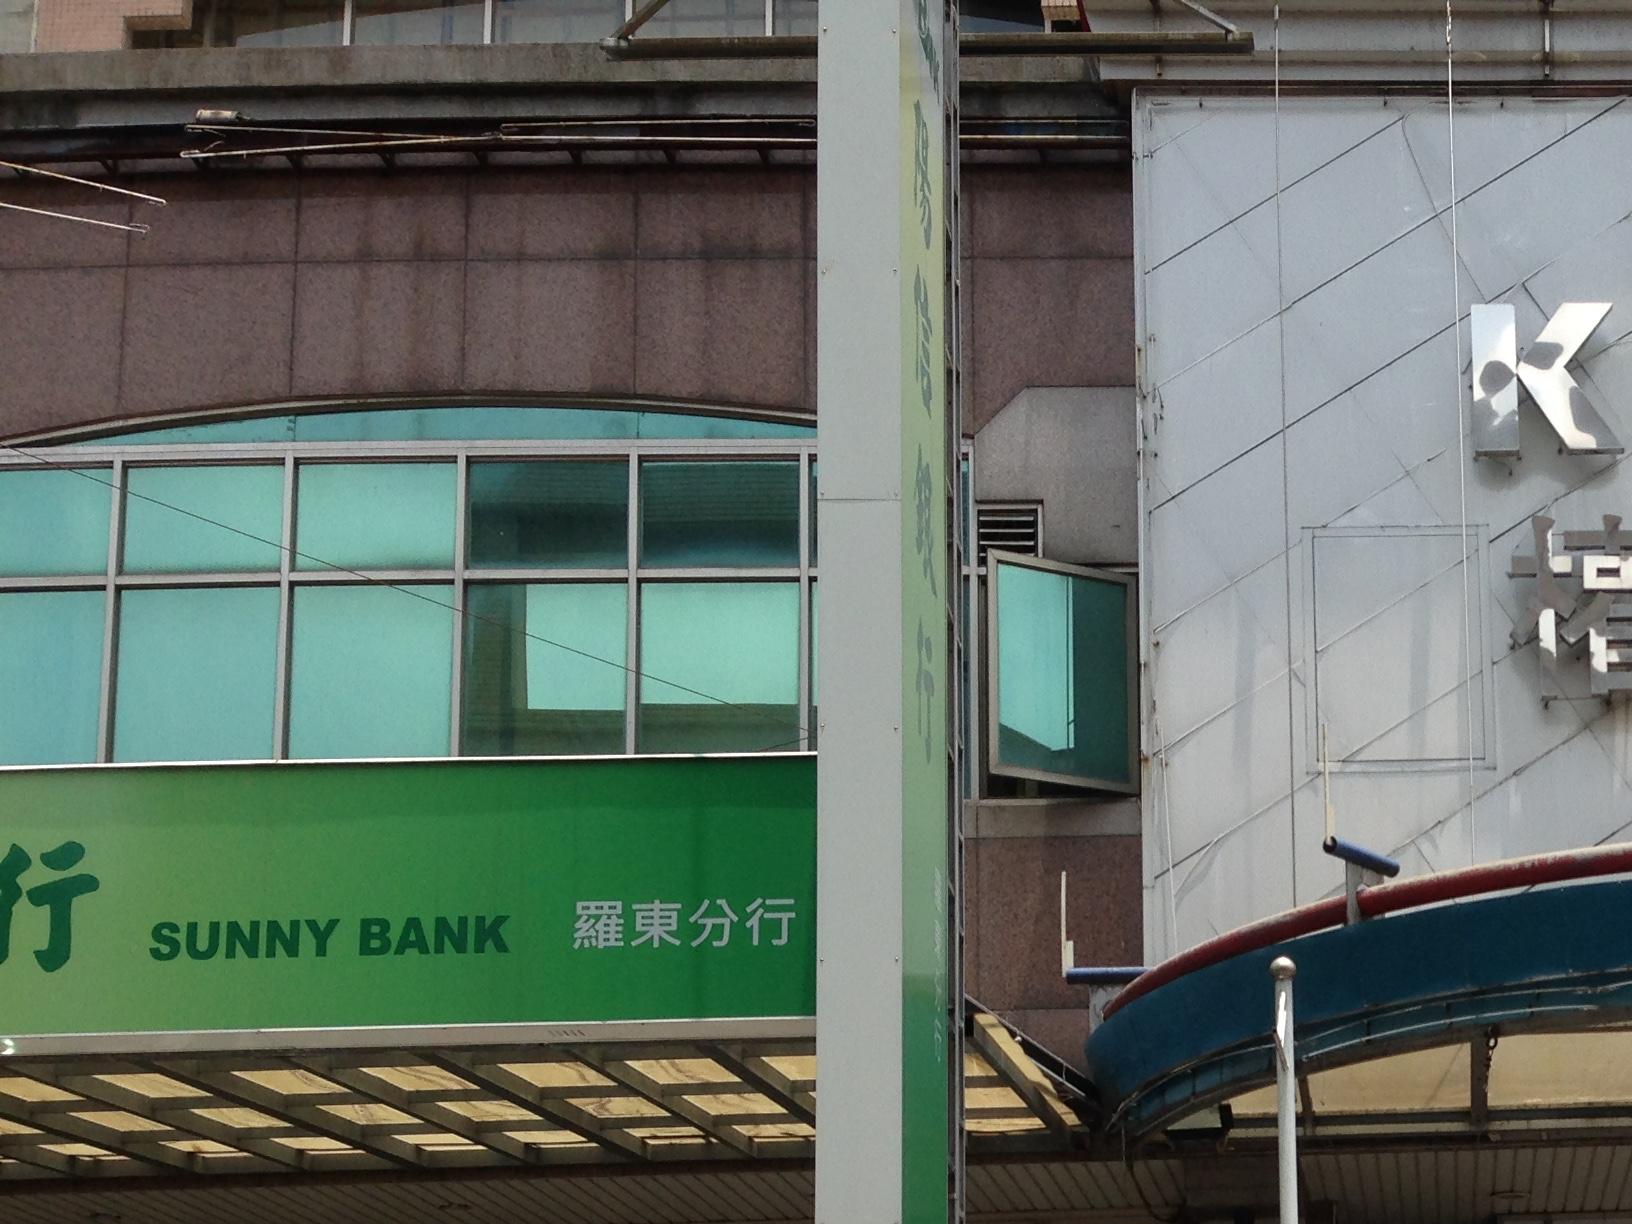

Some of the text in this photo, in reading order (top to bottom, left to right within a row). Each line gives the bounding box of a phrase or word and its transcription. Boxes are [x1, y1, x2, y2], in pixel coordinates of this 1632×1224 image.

[913, 98, 938, 765] 陽信銀行
[0, 840, 100, 973] 行
[149, 915, 511, 961] SUNNY BANK
[571, 897, 797, 951] 羅東分行
